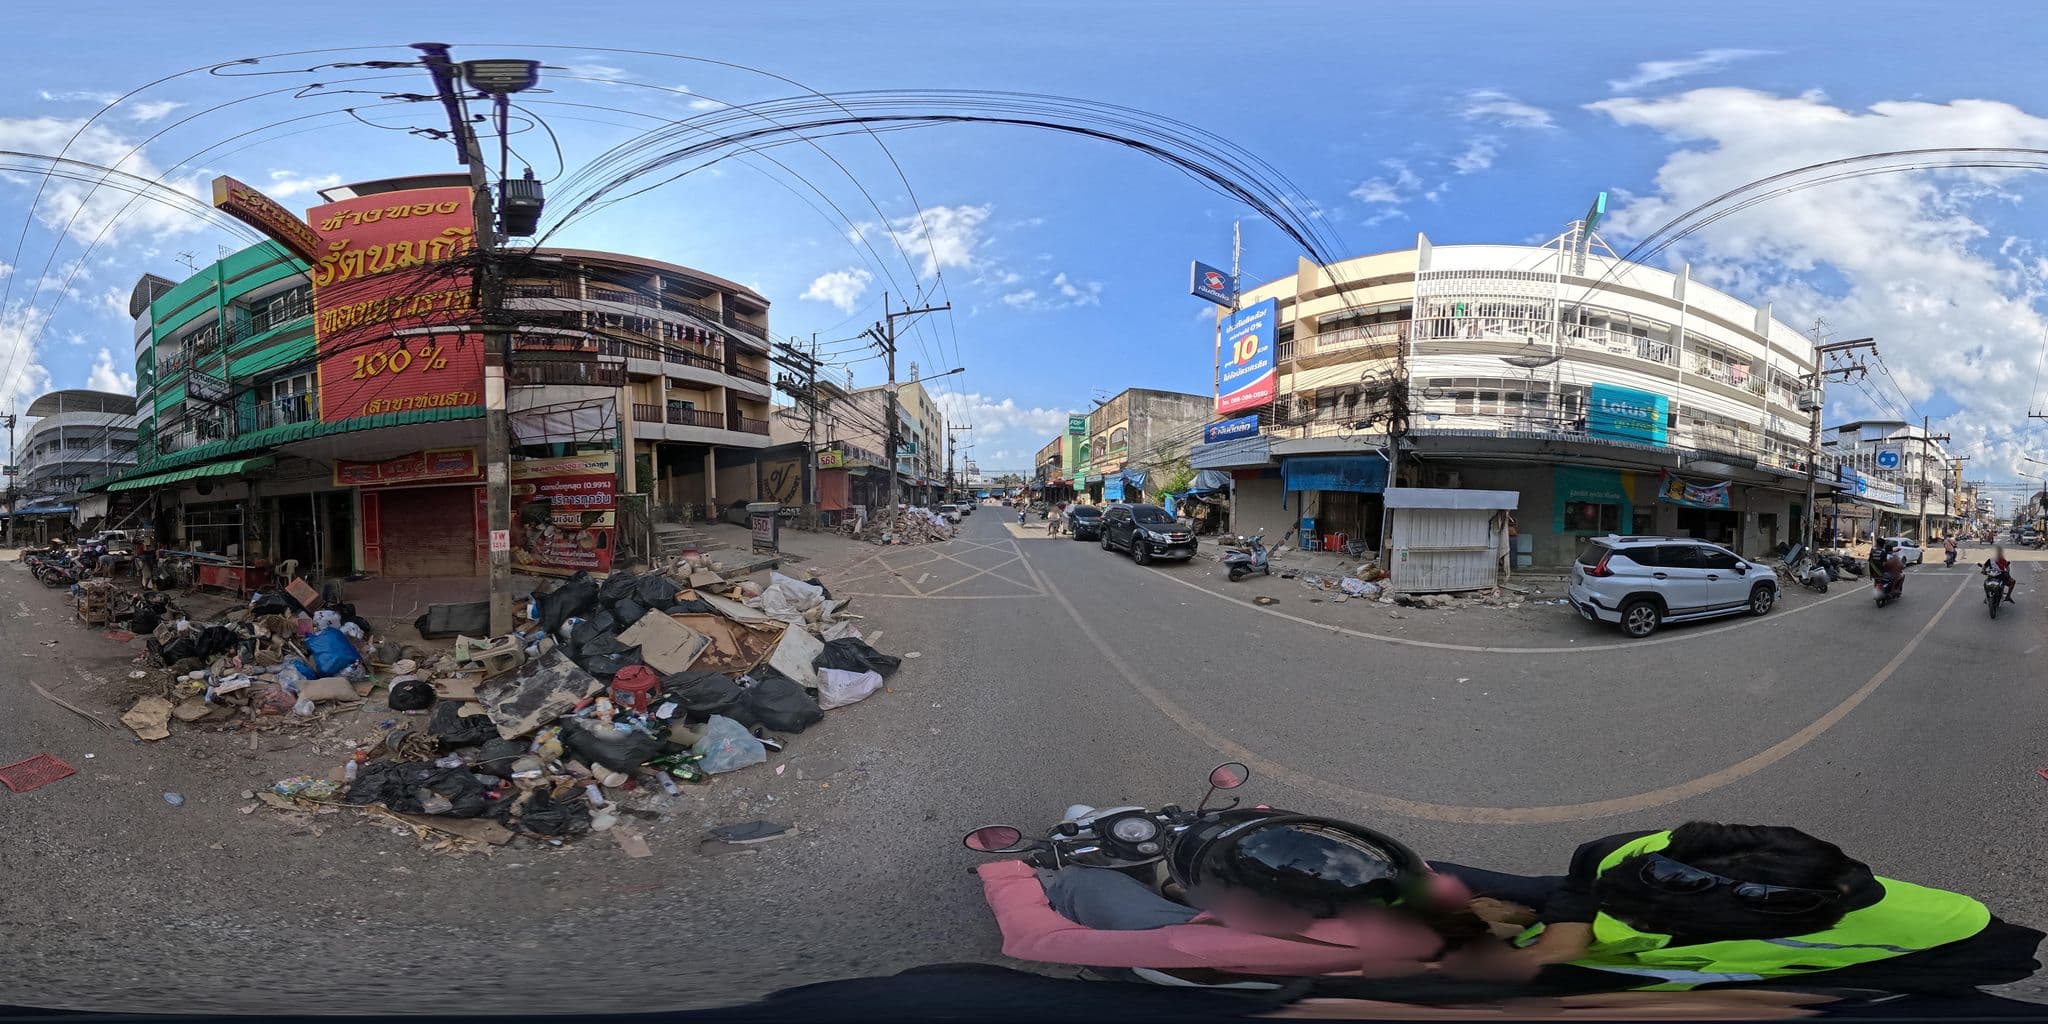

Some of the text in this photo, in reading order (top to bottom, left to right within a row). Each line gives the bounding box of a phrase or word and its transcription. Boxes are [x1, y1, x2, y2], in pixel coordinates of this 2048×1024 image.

[320, 200, 461, 232] ห้างทอง
[316, 227, 473, 287] รัตนมณี
[1233, 334, 1259, 365] 10
[363, 391, 477, 416] (สาขาท่งเสา)
